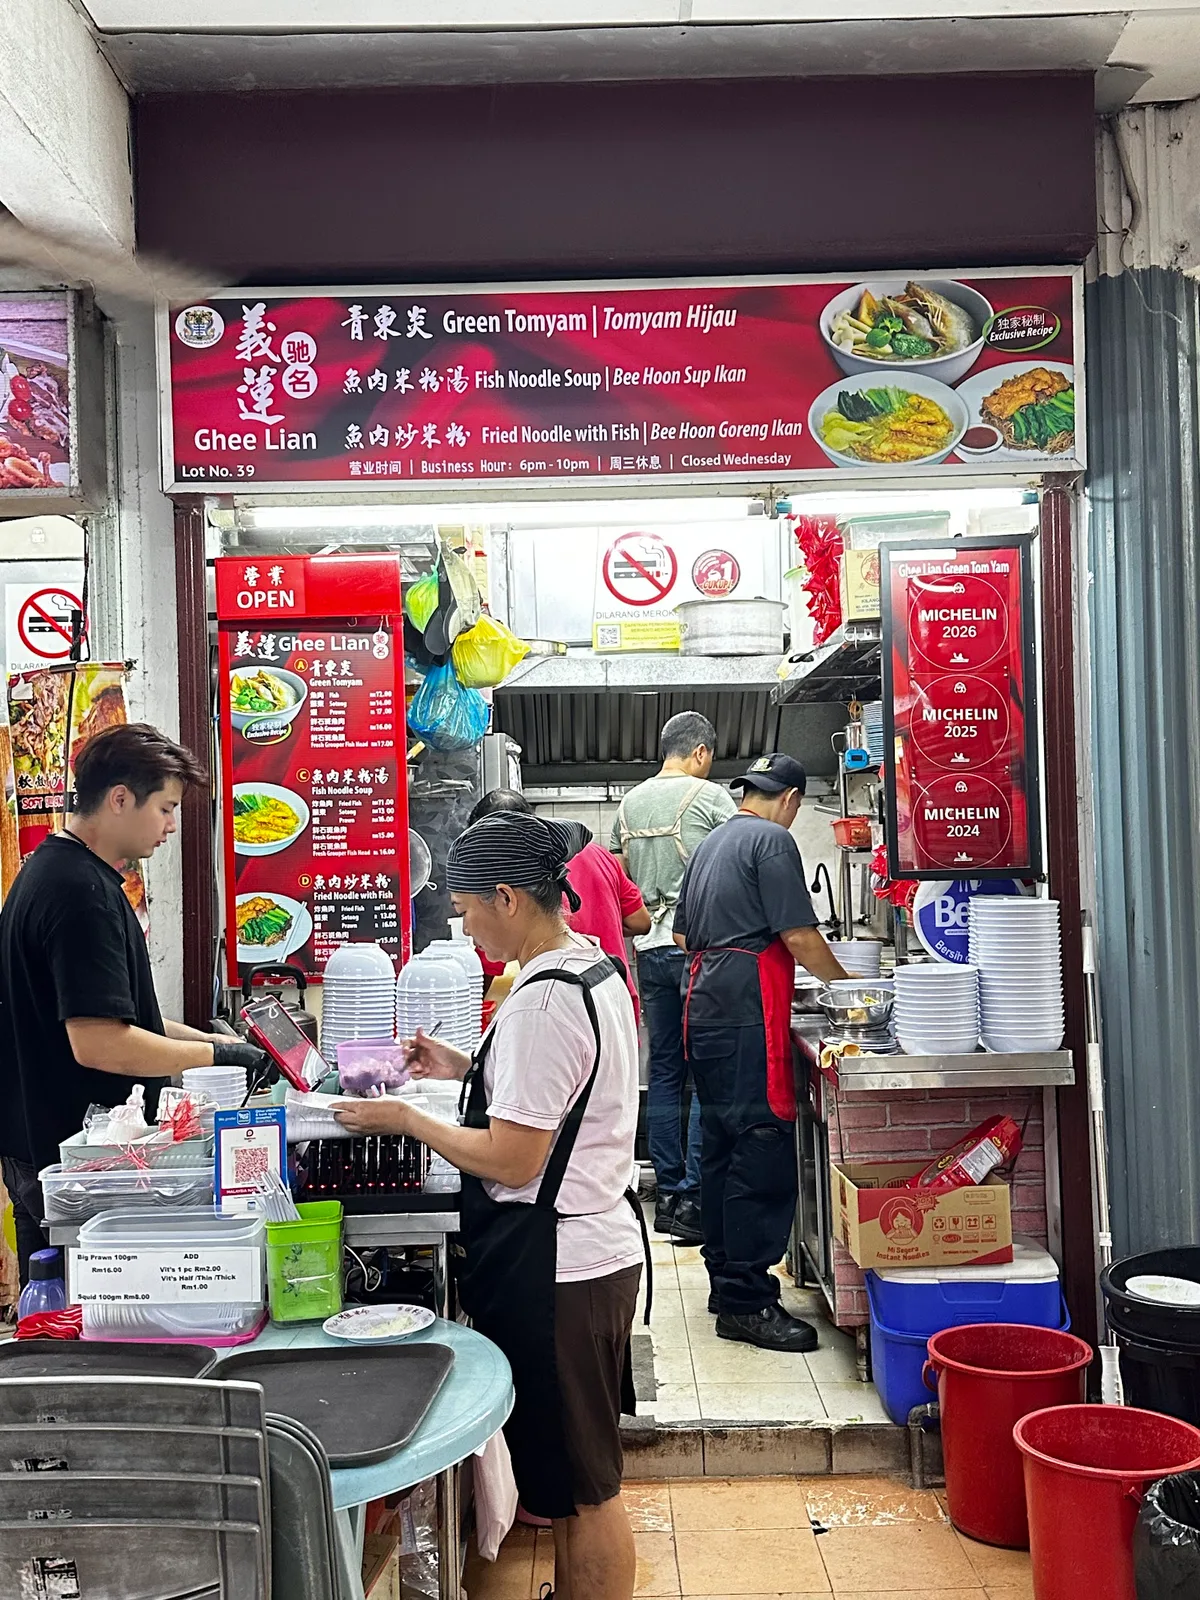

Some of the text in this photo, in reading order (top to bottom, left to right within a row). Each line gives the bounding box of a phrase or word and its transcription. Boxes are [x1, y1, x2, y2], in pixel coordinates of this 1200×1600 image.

[443, 304, 737, 338] Green Tomyam Tomyam Hijau
[998, 313, 1045, 330] 独家秘制
[990, 325, 1054, 342] Exclusive Recipe
[286, 340, 310, 393] 驰名
[342, 365, 470, 394] 魚肉米粉湯
[475, 364, 746, 391] Fish Noodle Soup Bee Hoon Sup Ikan
[194, 428, 317, 450] Ghee Lian
[344, 422, 471, 449] 魚肉炒米粉
[482, 419, 803, 444] Fried Noodle with Fish Bee Hoon Goreng Ikan
[421, 460, 474, 474] Business
[480, 459, 513, 473] Hour:
[609, 455, 662, 471] 周三休息
[681, 452, 791, 467] Closed Wednesday
[182, 465, 255, 477] Lot No. 39
[349, 461, 401, 476] 营业时间
[899, 564, 921, 577] Ghee
[943, 562, 969, 574] Green
[970, 561, 989, 573] Tom
[990, 560, 1010, 573] Yam
[236, 590, 295, 608] OPEN
[596, 611, 640, 619] DILARANG
[921, 608, 997, 622] MICHELIN
[942, 626, 977, 638] 2026
[279, 635, 370, 651] Ghee Lian
[309, 678, 363, 688] Green Tomyam
[922, 707, 998, 721] MICHELIN
[943, 725, 978, 738] 2025
[299, 771, 307, 779] C
[311, 767, 389, 785] 魚肉米粉湯
[311, 786, 373, 795] Fish Noodle Soup
[22, 797, 43, 809] SOFT
[924, 807, 1000, 821] MICHELIN
[946, 824, 980, 837] 2024
[301, 877, 309, 885] D
[313, 873, 391, 890] 魚肉炒米粉
[313, 890, 393, 900] Fried Noodle with Fish
[935, 940, 963, 962] Bersih
[876, 1251, 930, 1261] Instant Noodles
[896, 1246, 919, 1254] Segera
